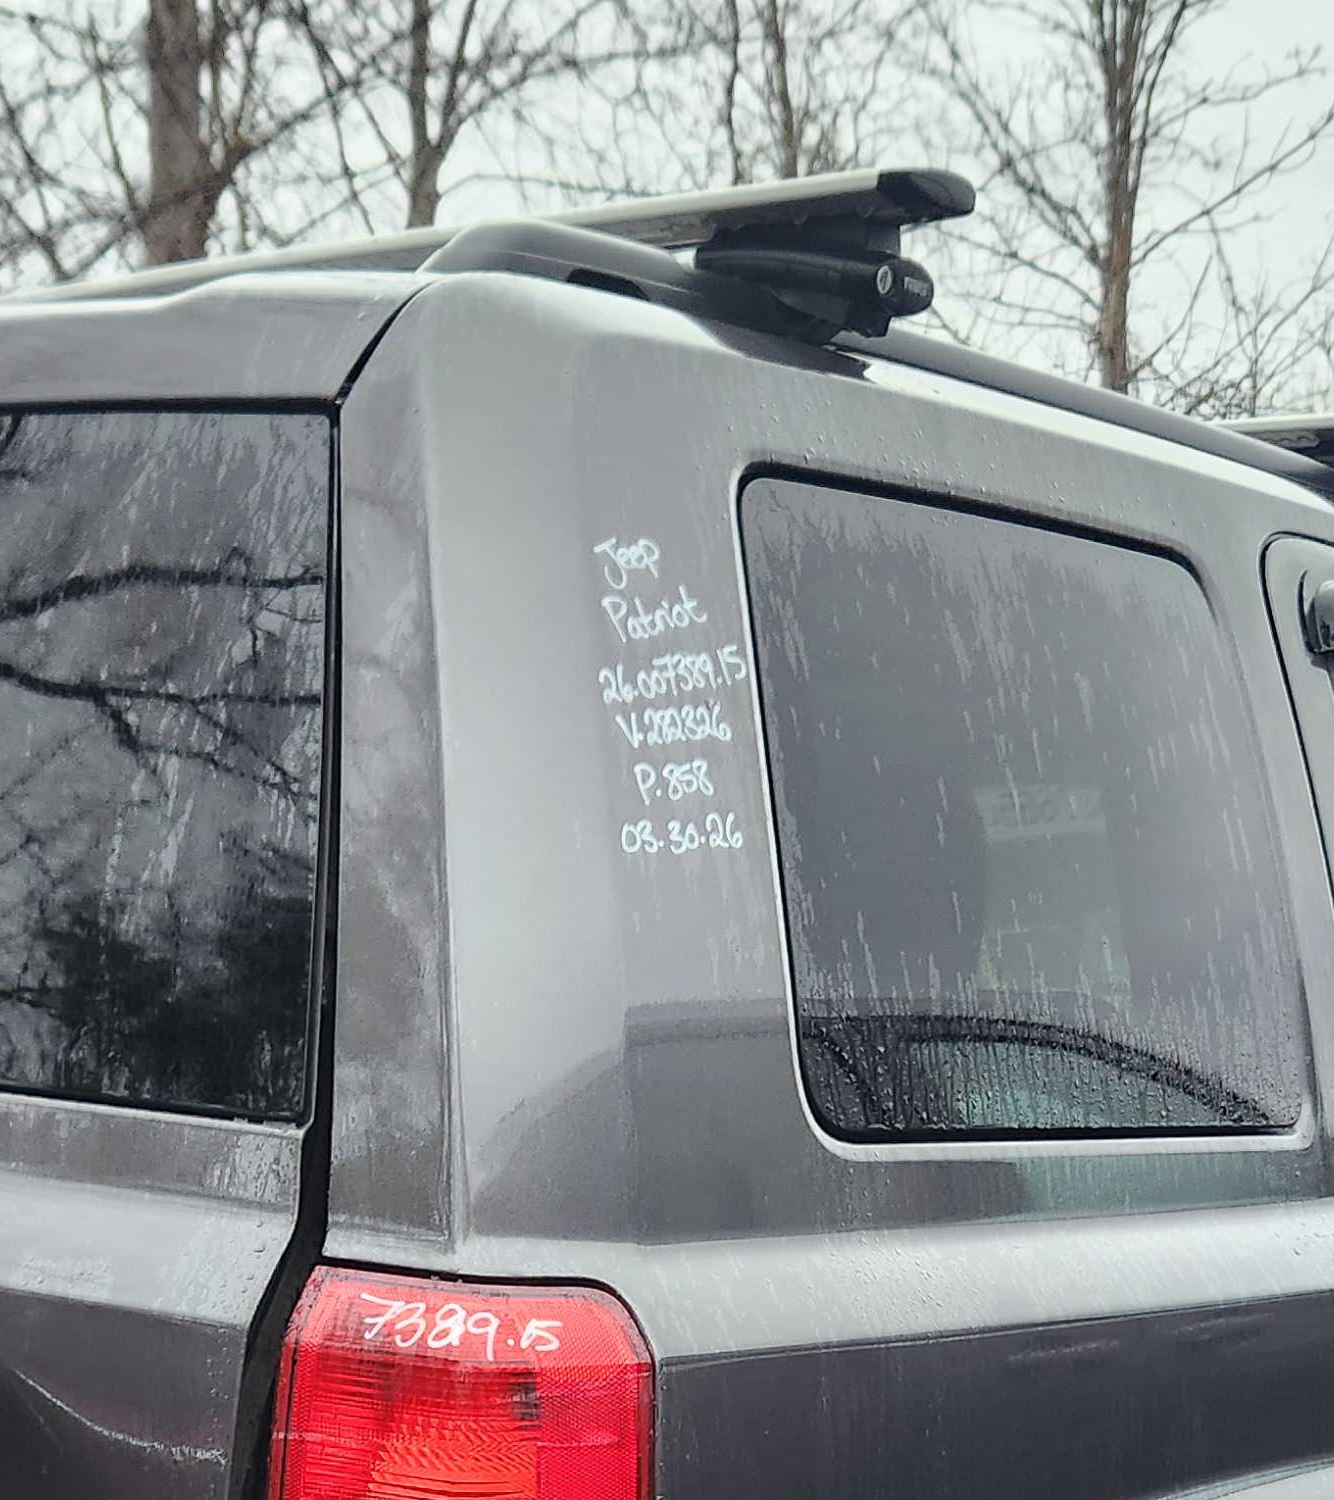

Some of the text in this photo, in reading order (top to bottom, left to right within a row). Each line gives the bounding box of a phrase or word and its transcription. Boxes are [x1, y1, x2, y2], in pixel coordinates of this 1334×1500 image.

[593, 537, 661, 590] Jeep
[601, 585, 708, 643] Patriot
[634, 758, 714, 806] P.858
[621, 811, 744, 855] 03.30.26
